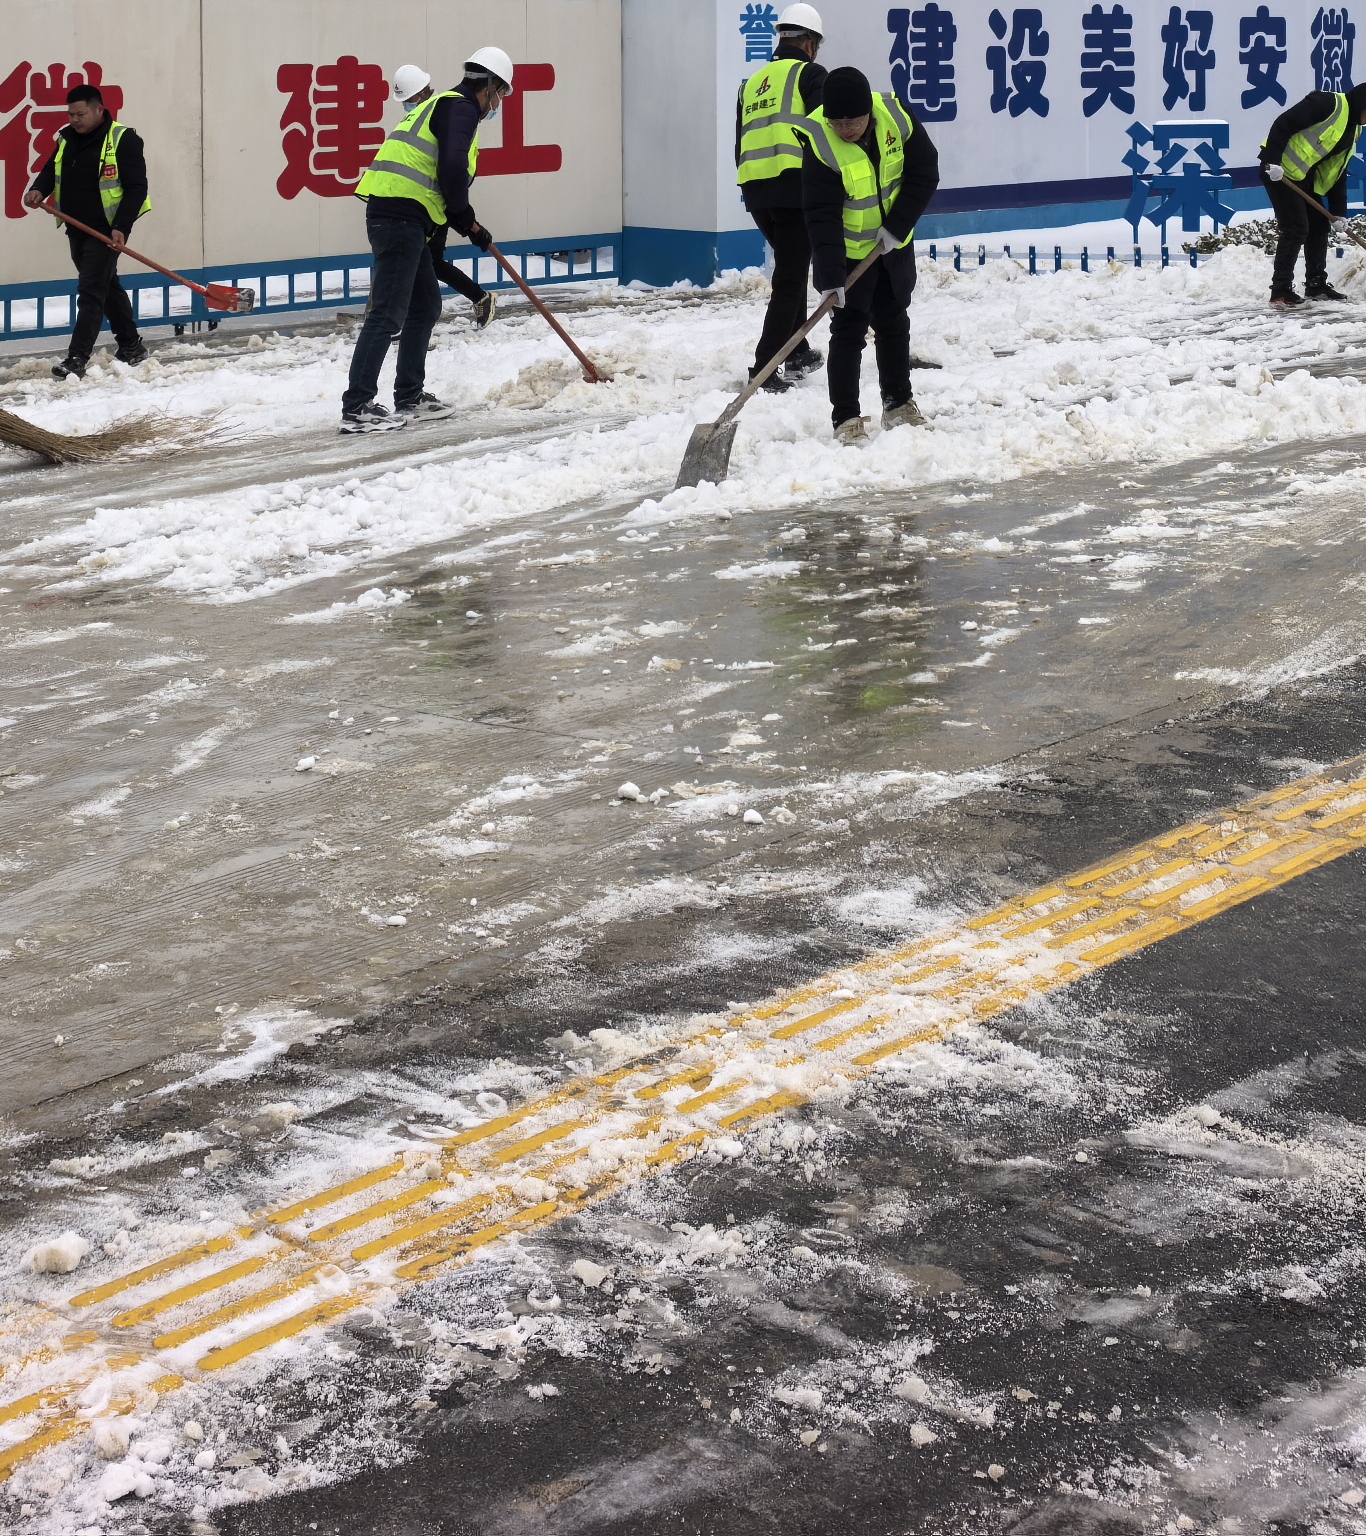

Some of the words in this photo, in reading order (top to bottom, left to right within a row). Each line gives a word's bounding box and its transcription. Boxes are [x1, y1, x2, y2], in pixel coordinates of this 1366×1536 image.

[887, 2, 1357, 123] 建设美好安徽
[745, 97, 777, 116] 安徽建工
